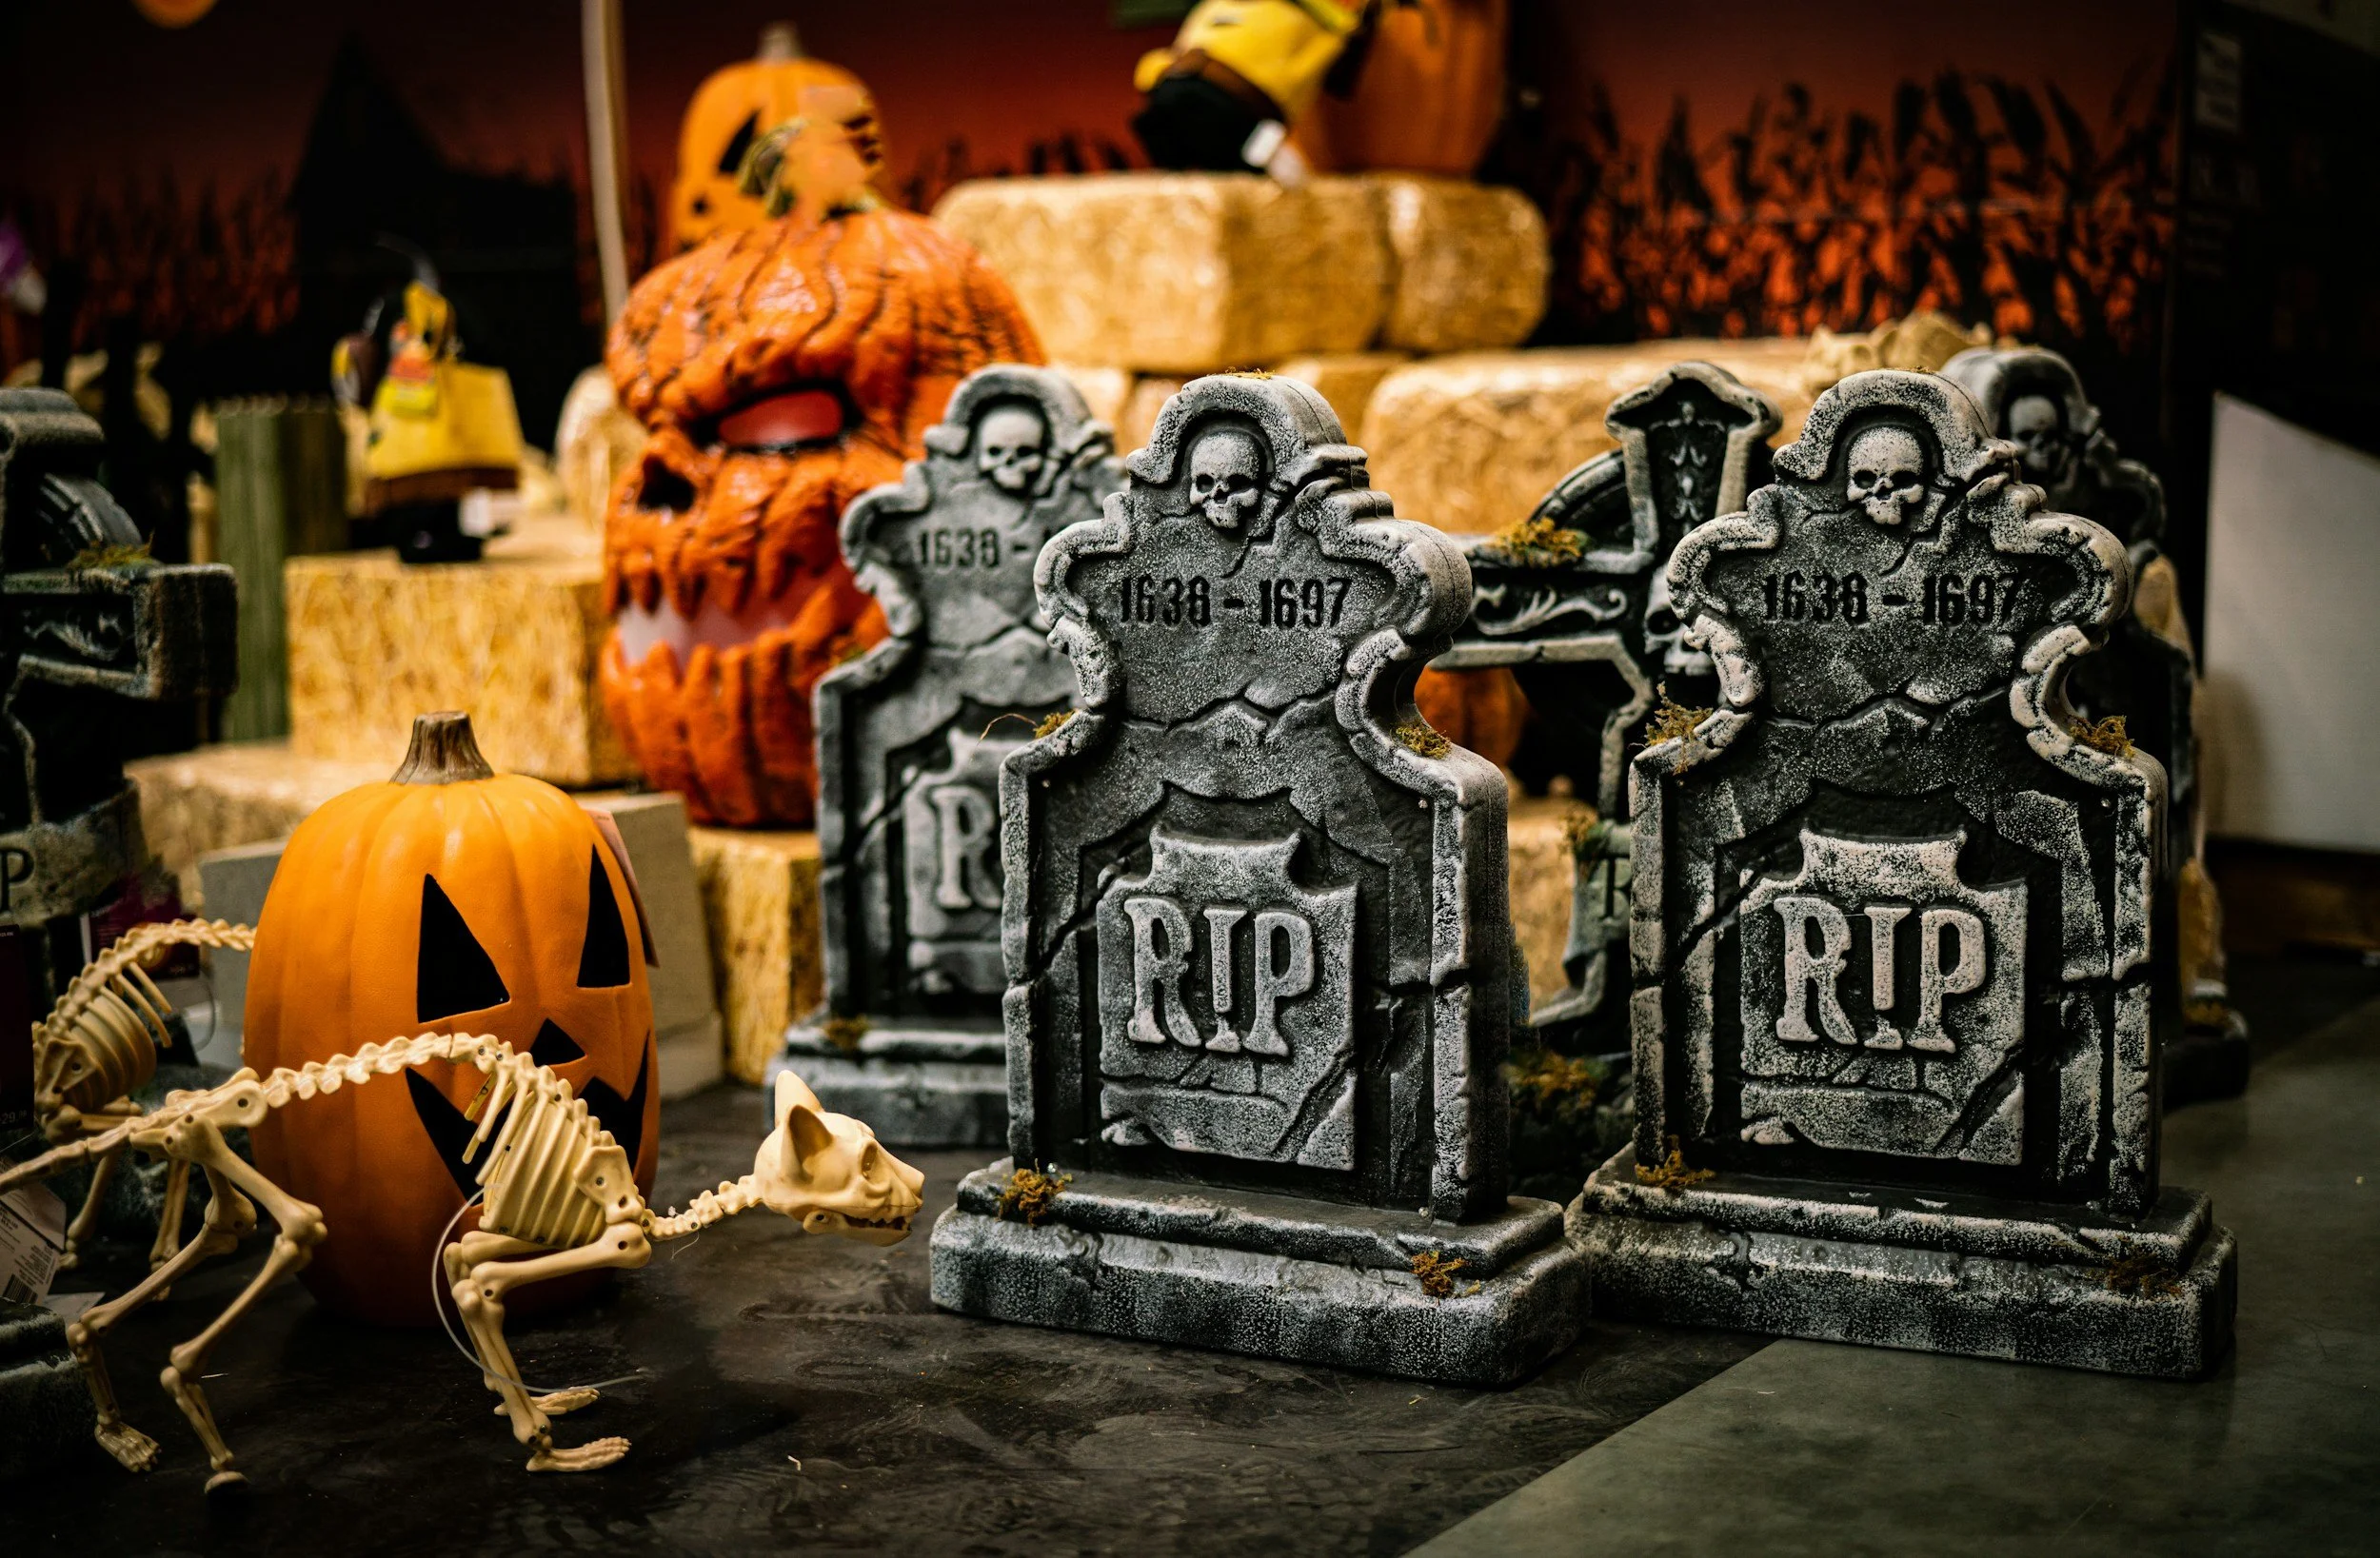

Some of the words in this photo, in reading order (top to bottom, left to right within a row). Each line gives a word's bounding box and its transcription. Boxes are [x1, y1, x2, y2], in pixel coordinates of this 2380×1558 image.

[920, 527, 1000, 568] 1638
[1120, 573, 1212, 628] 1638
[1259, 577, 1353, 628] 1697
[1761, 570, 1868, 622] 1638
[1922, 572, 2019, 626] 1697
[1123, 897, 1316, 1056] RIP
[1773, 897, 1987, 1054] RIP
